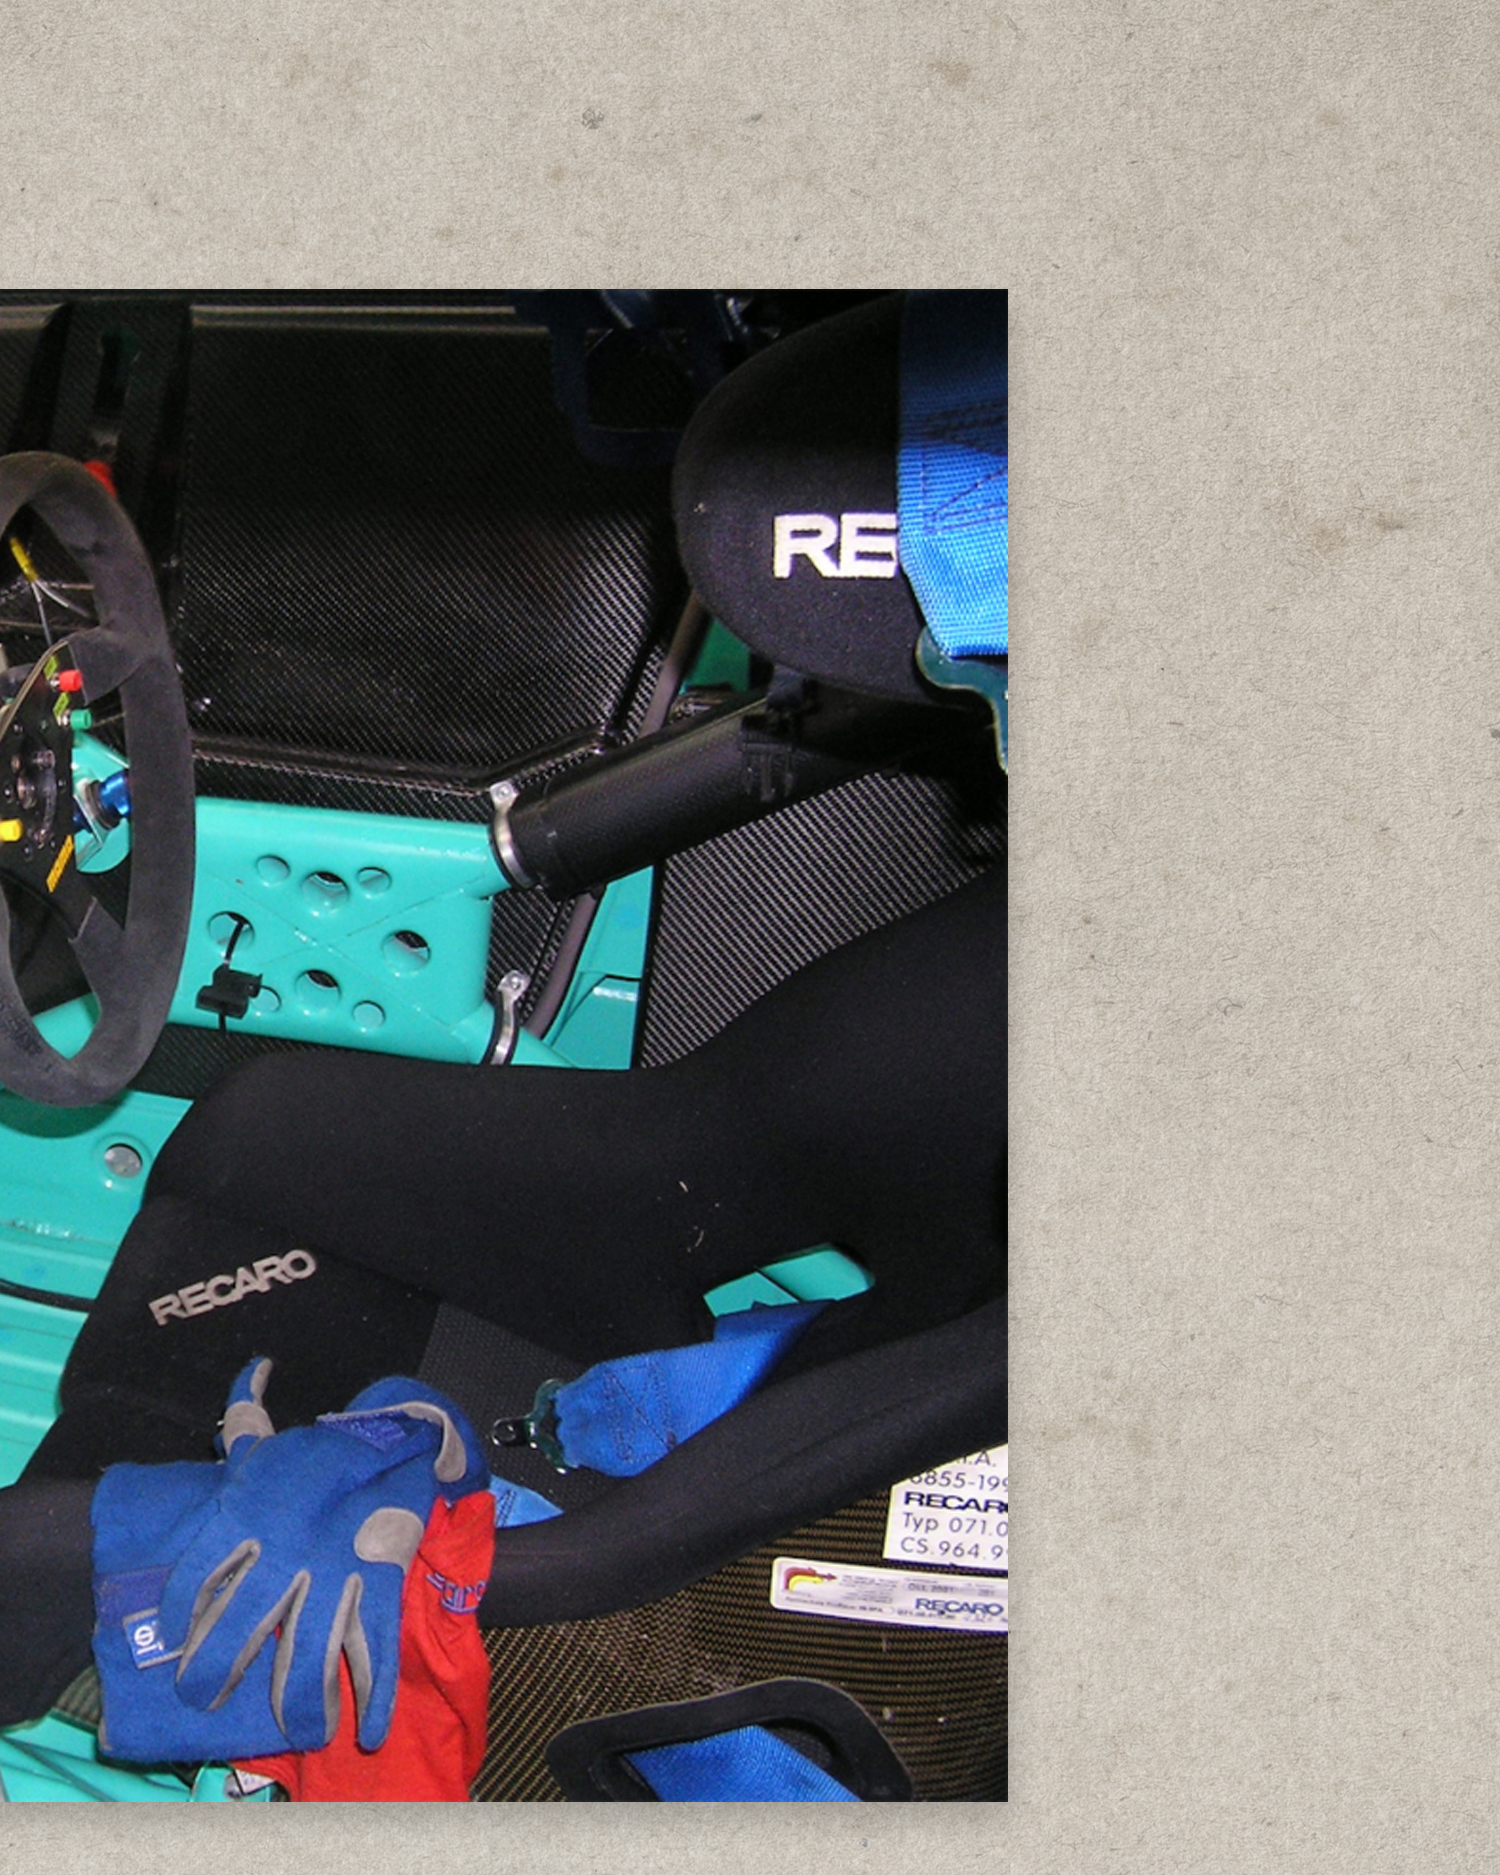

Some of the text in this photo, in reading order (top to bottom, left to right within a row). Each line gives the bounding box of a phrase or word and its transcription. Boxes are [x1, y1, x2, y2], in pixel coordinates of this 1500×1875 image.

[773, 512, 899, 580] RE
[147, 1248, 319, 1327] RECARO
[902, 1511, 939, 1534] Typ
[900, 1536, 1008, 1560] CS.964.9
[915, 1598, 1004, 1616] RECARO
